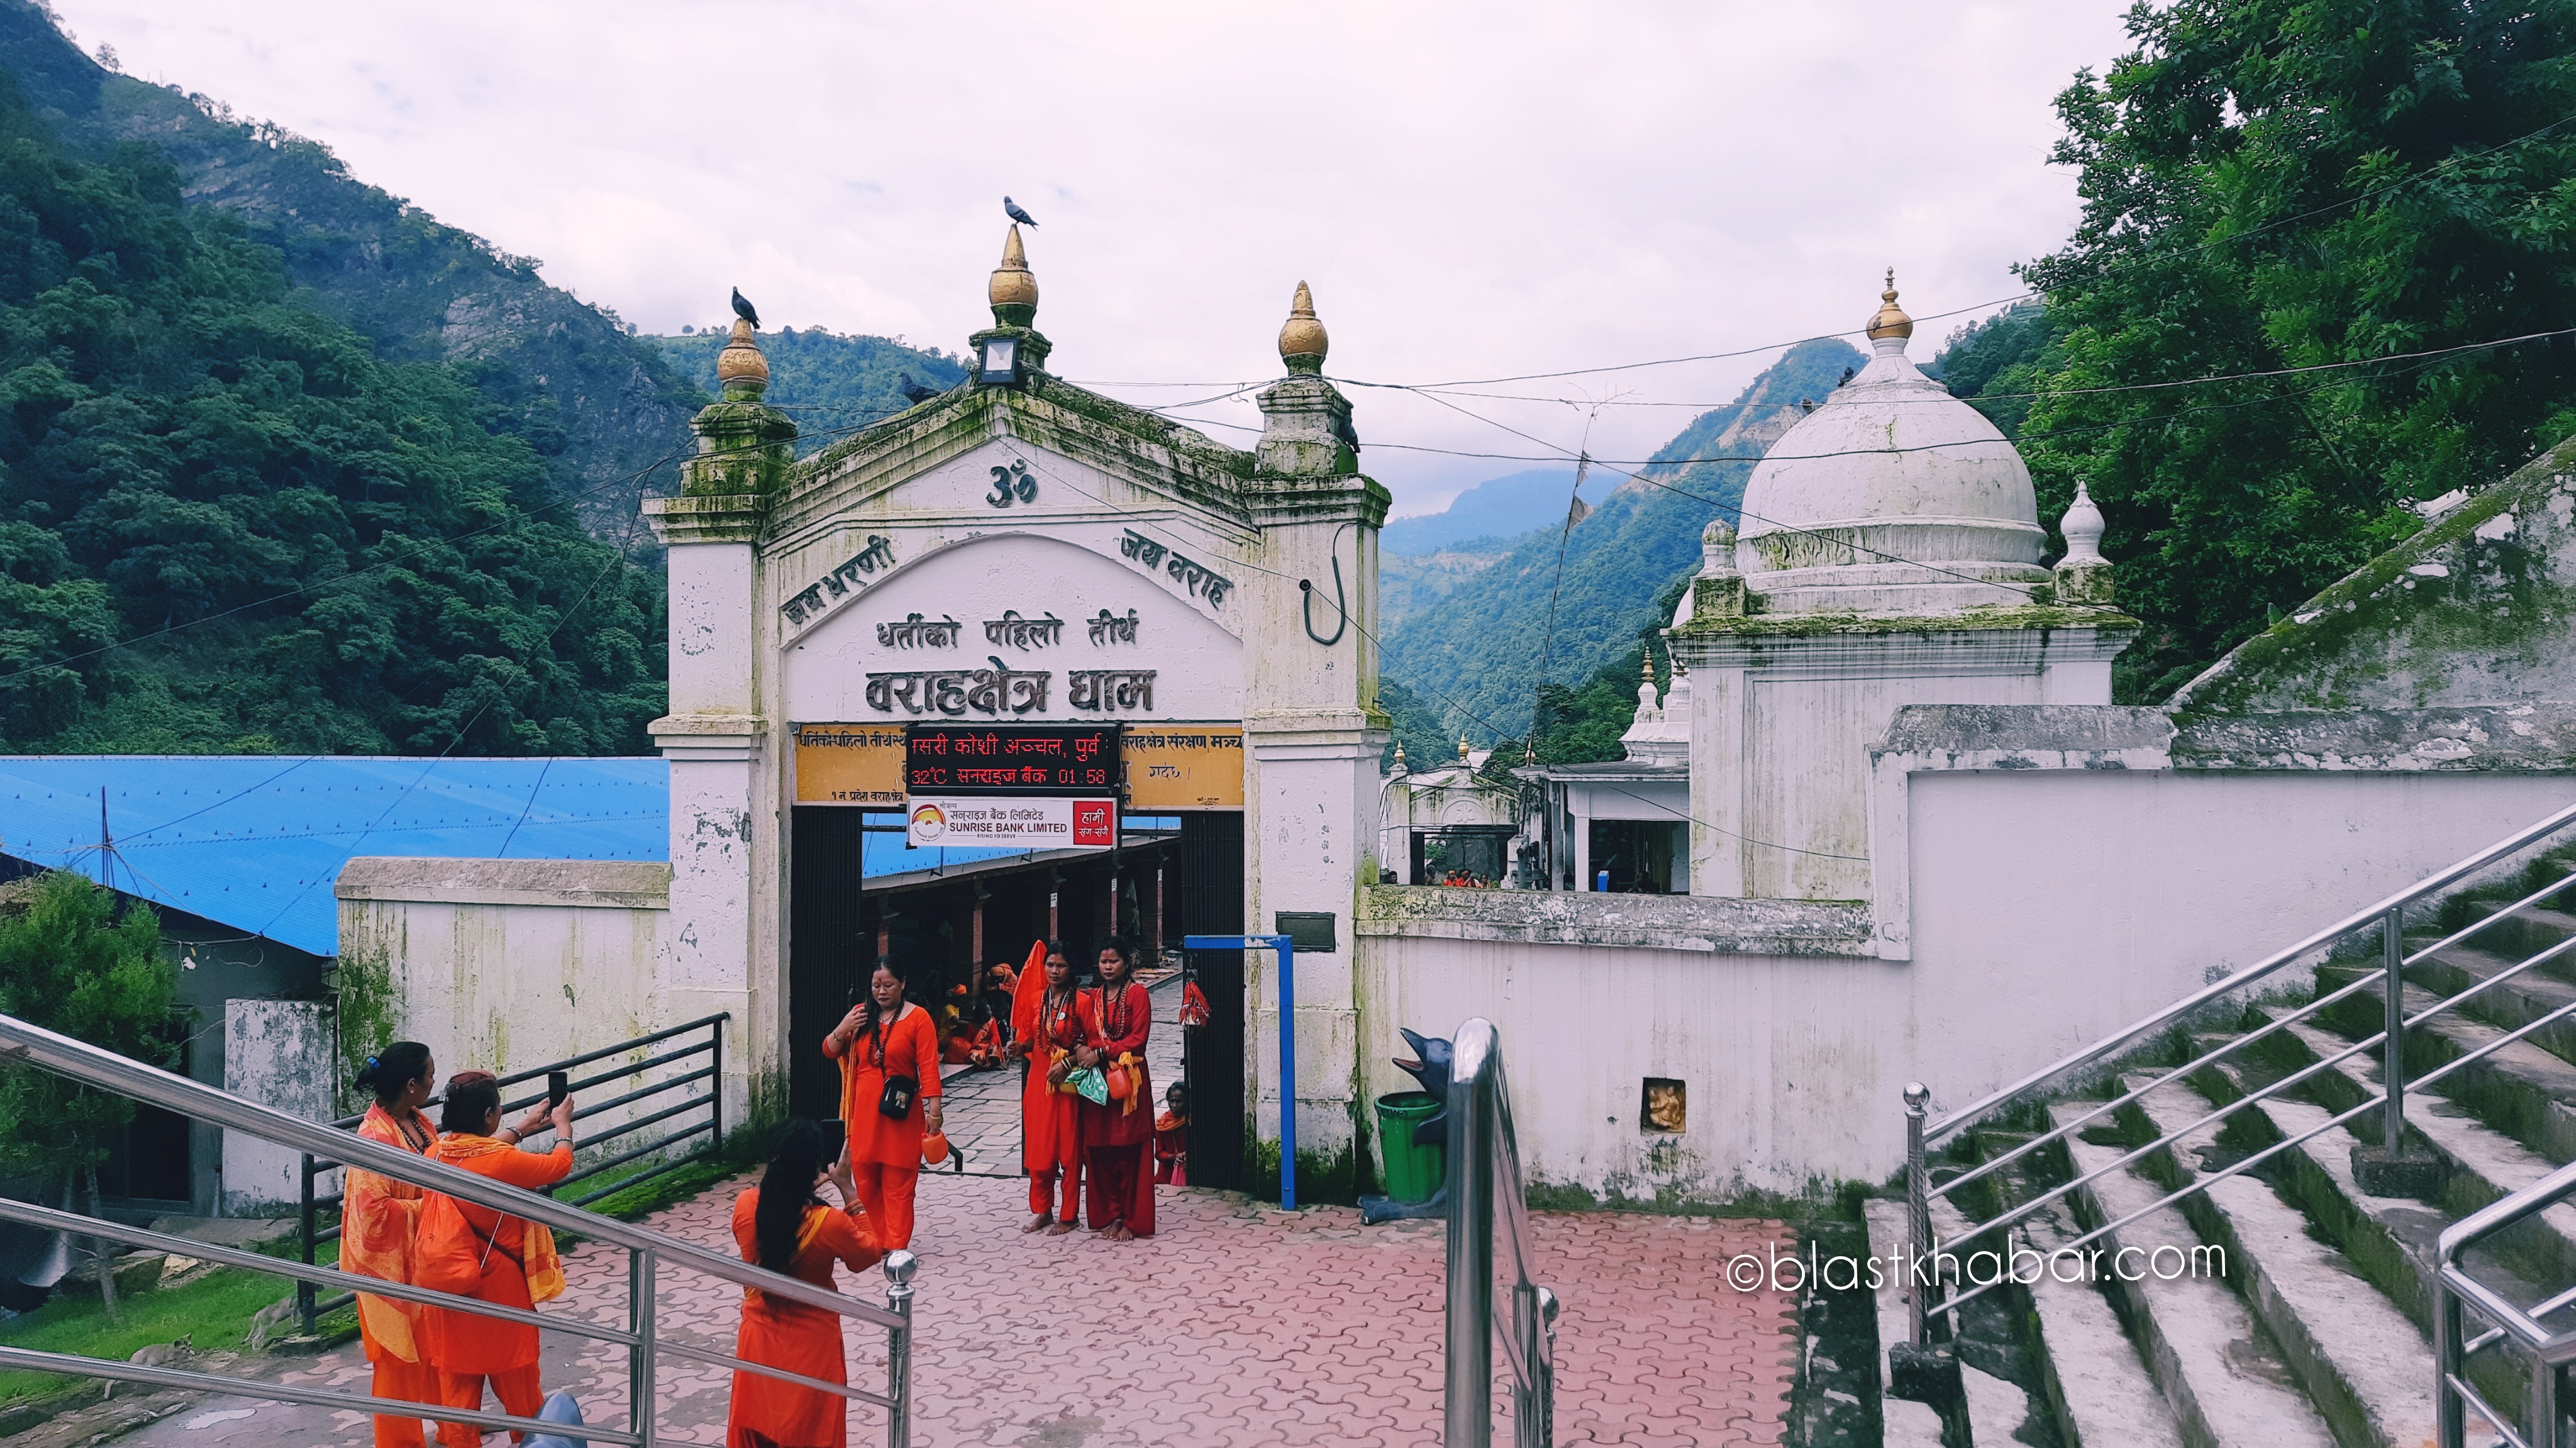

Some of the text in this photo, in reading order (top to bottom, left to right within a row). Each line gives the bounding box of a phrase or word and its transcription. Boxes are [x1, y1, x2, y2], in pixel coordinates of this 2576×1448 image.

[985, 459, 1038, 508] ॐ
[1121, 527, 1235, 611] जय वराह
[982, 610, 1065, 652] पहिलो
[1086, 608, 1140, 647] तीर्थ
[865, 655, 1052, 716] वराहक्षेत्र
[1167, 733, 1207, 752] संरक्षण
[950, 822, 1067, 833] SUNRISE BANK LIMITED
[1009, 808, 1044, 821] लिमिटेड
[1080, 808, 1106, 825] हामी
